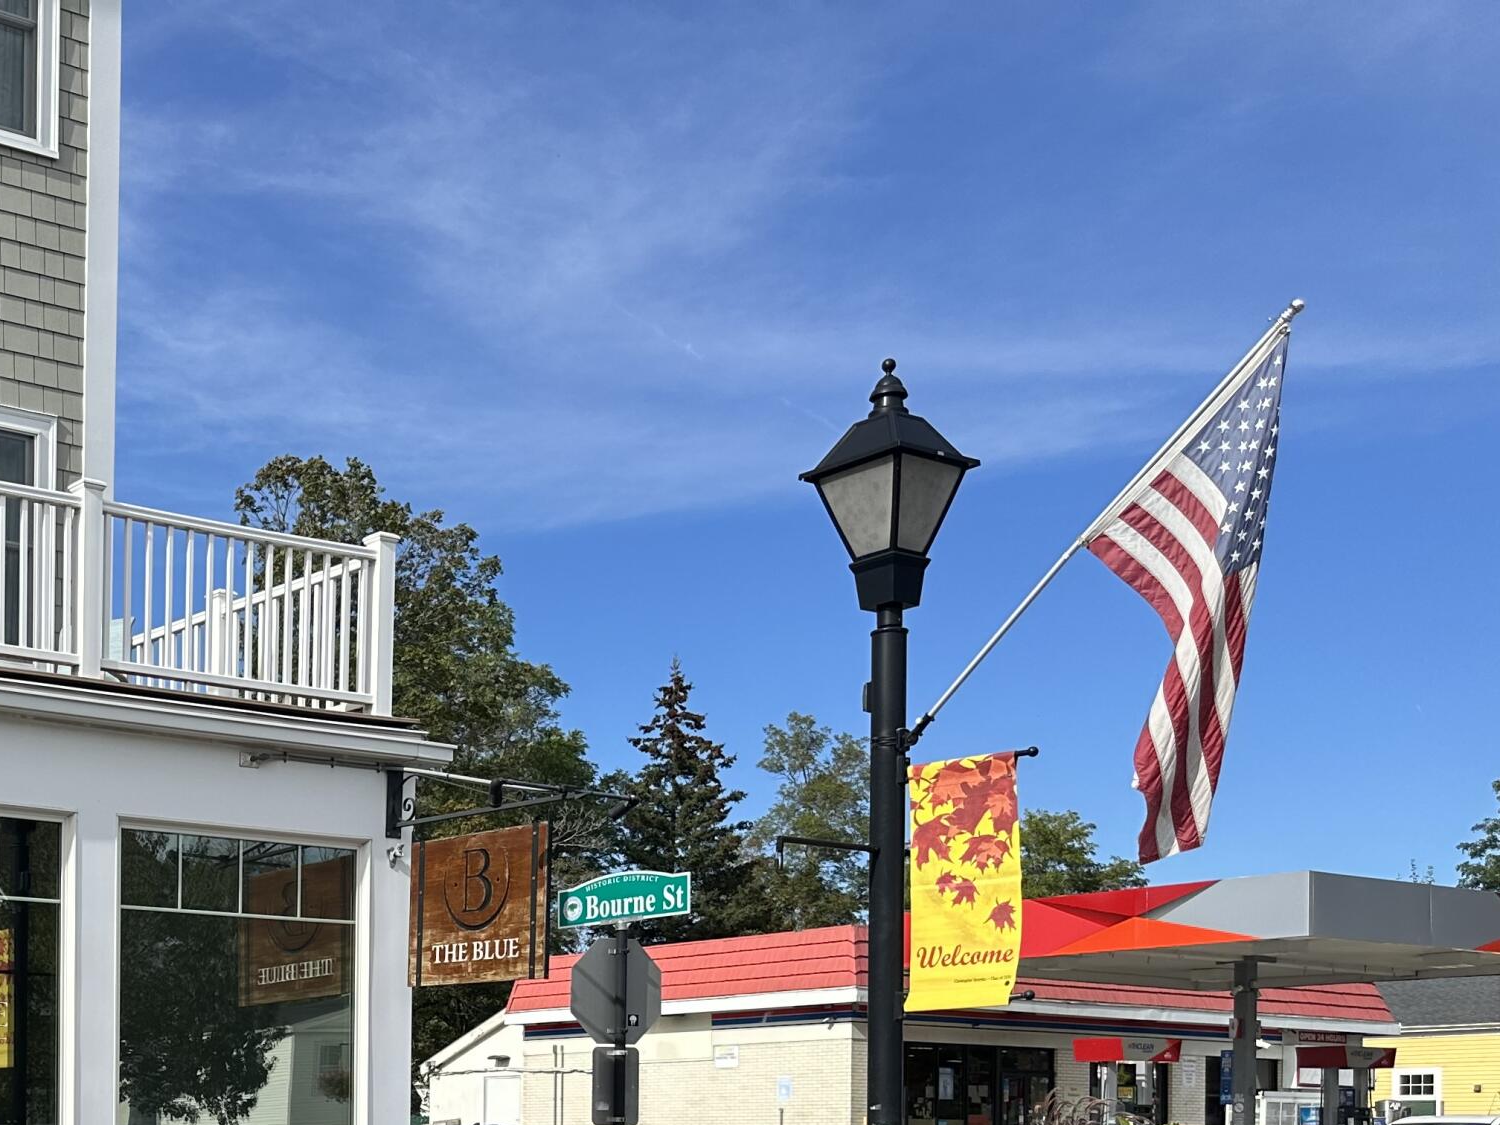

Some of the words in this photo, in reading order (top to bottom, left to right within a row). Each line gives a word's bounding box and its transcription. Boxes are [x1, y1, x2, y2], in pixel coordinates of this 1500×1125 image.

[462, 848, 492, 912] B
[585, 876, 620, 892] HISTORIC
[623, 874, 659, 883] DISTRICT
[585, 894, 656, 920] Bourne
[663, 884, 684, 910] St
[431, 942, 468, 964] THE
[472, 938, 520, 961] BLUE
[916, 944, 1014, 968] Welcome
